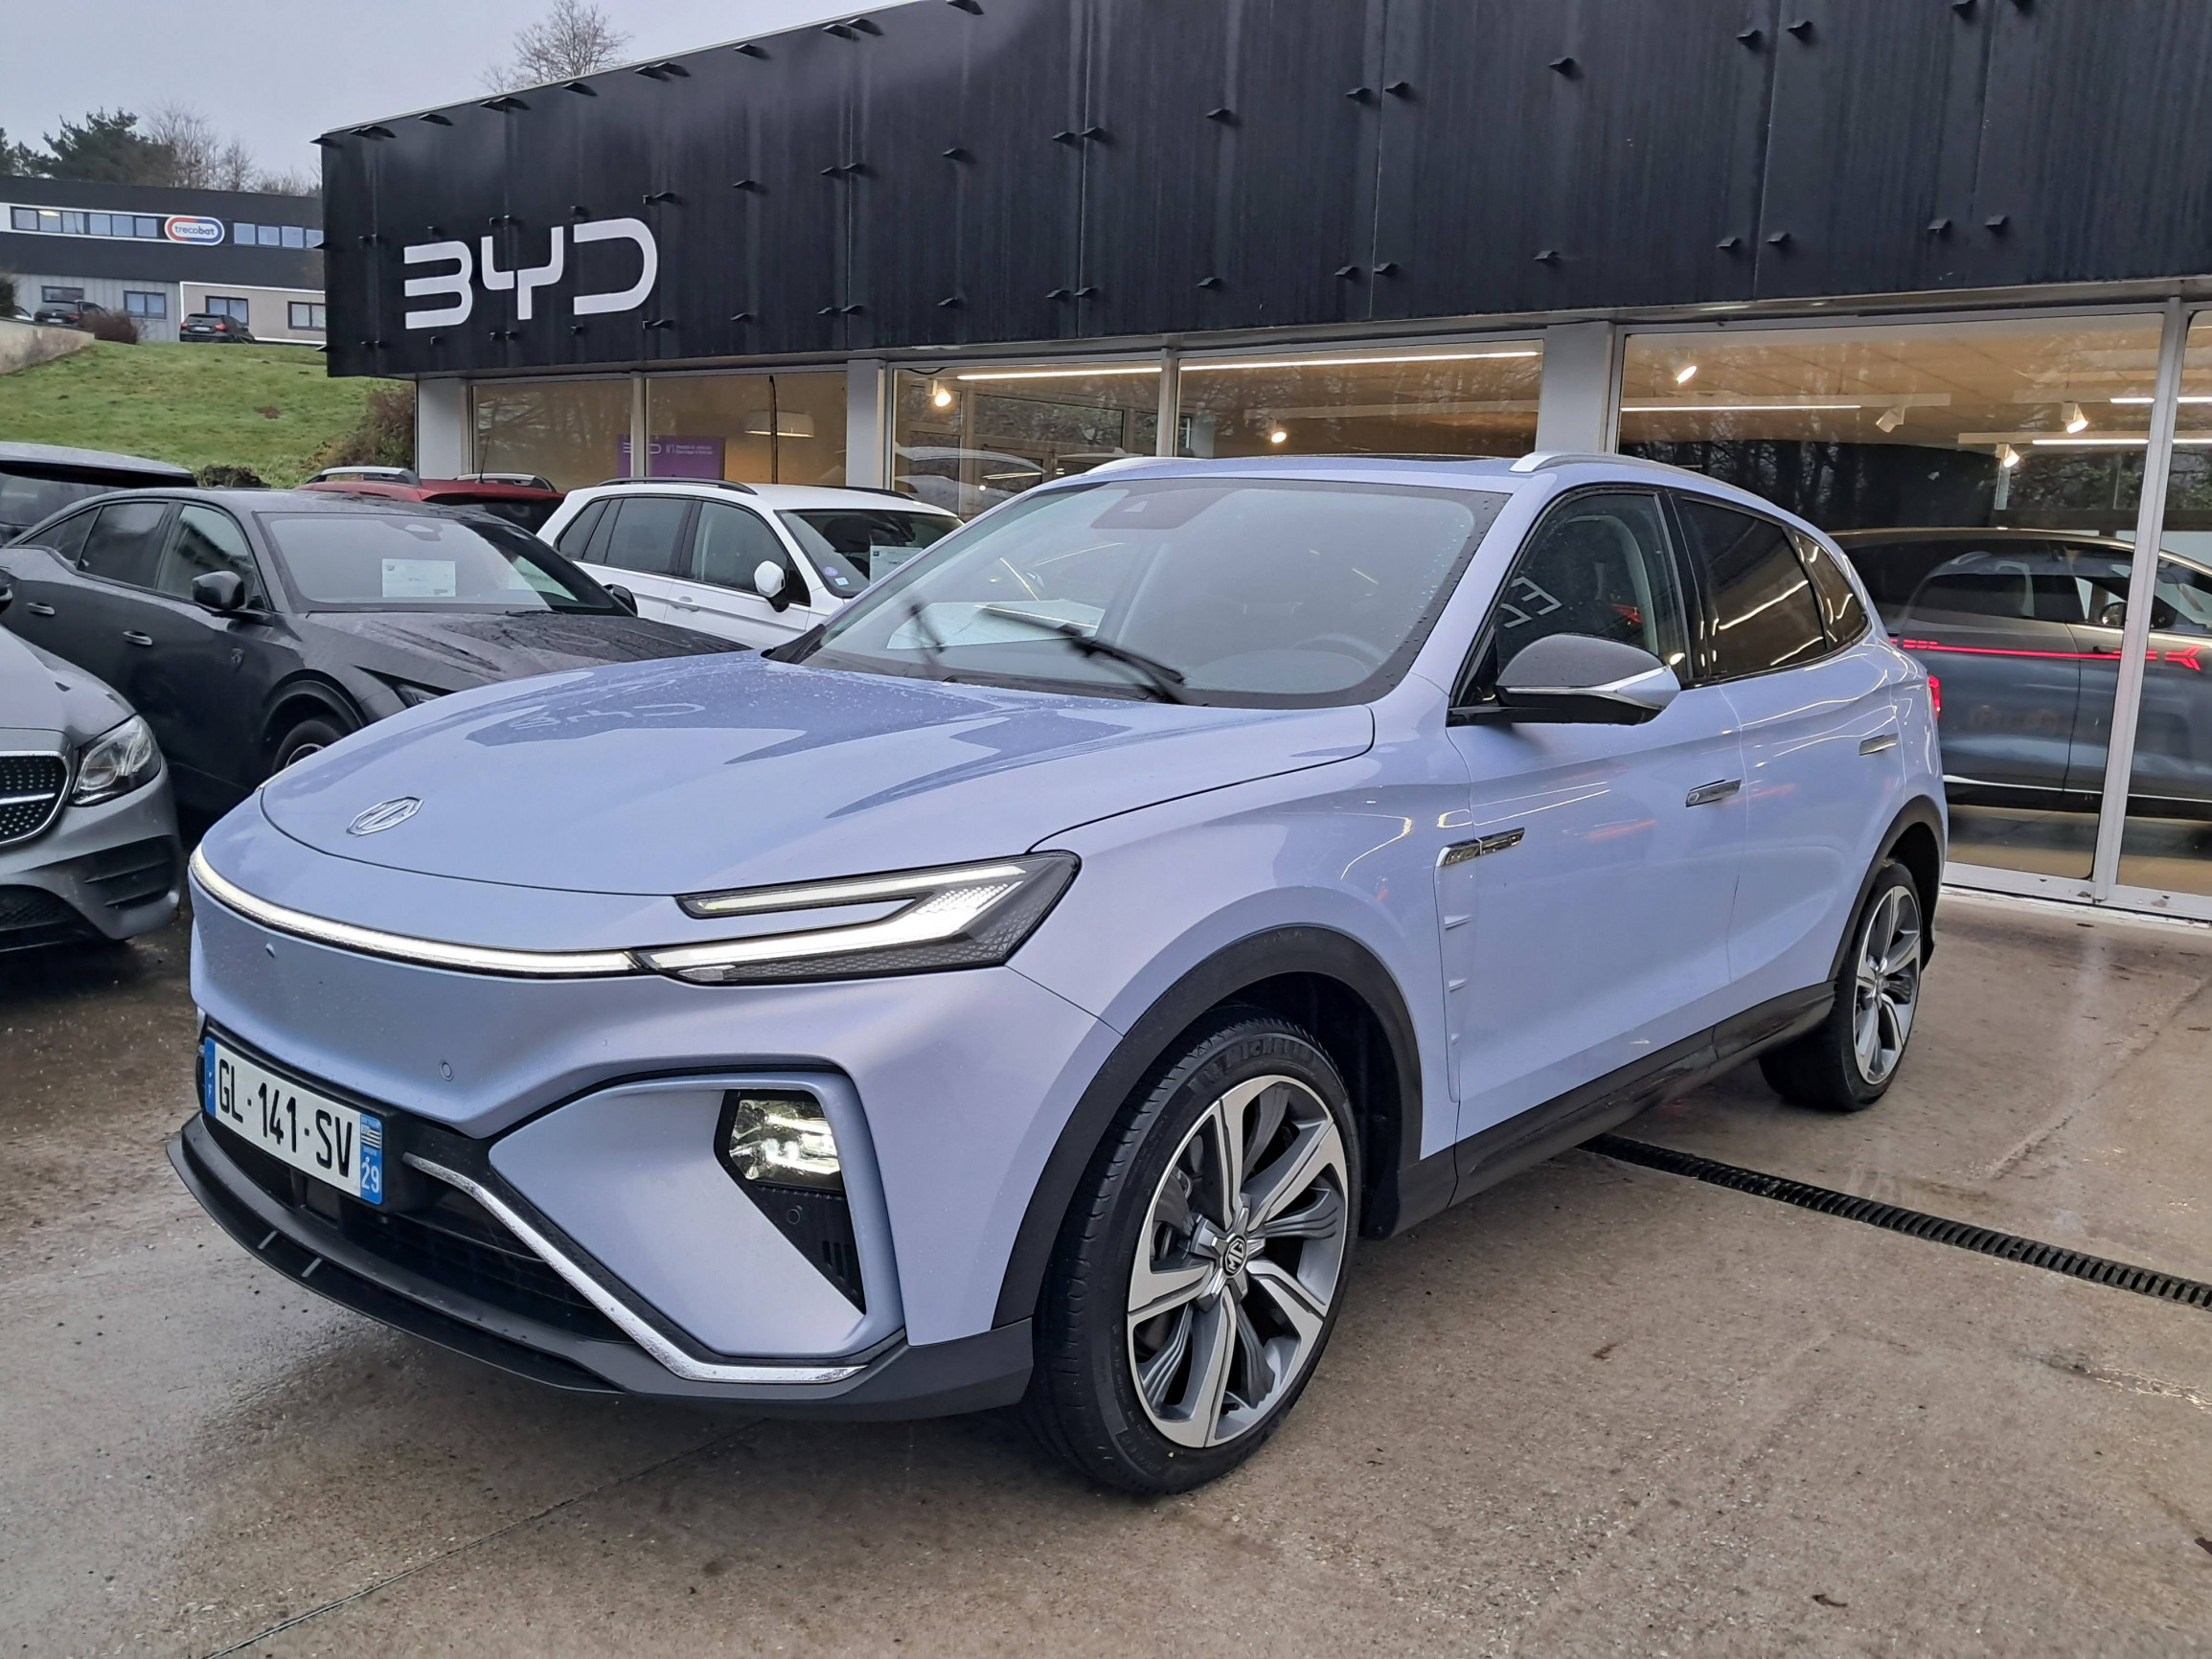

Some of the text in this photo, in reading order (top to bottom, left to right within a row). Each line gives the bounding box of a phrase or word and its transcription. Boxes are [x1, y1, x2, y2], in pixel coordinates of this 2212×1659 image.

[174, 225, 216, 237] trecobat
[403, 217, 658, 330] BYD
[361, 1162, 380, 1194] 29
[1227, 1240, 1244, 1271] MG
